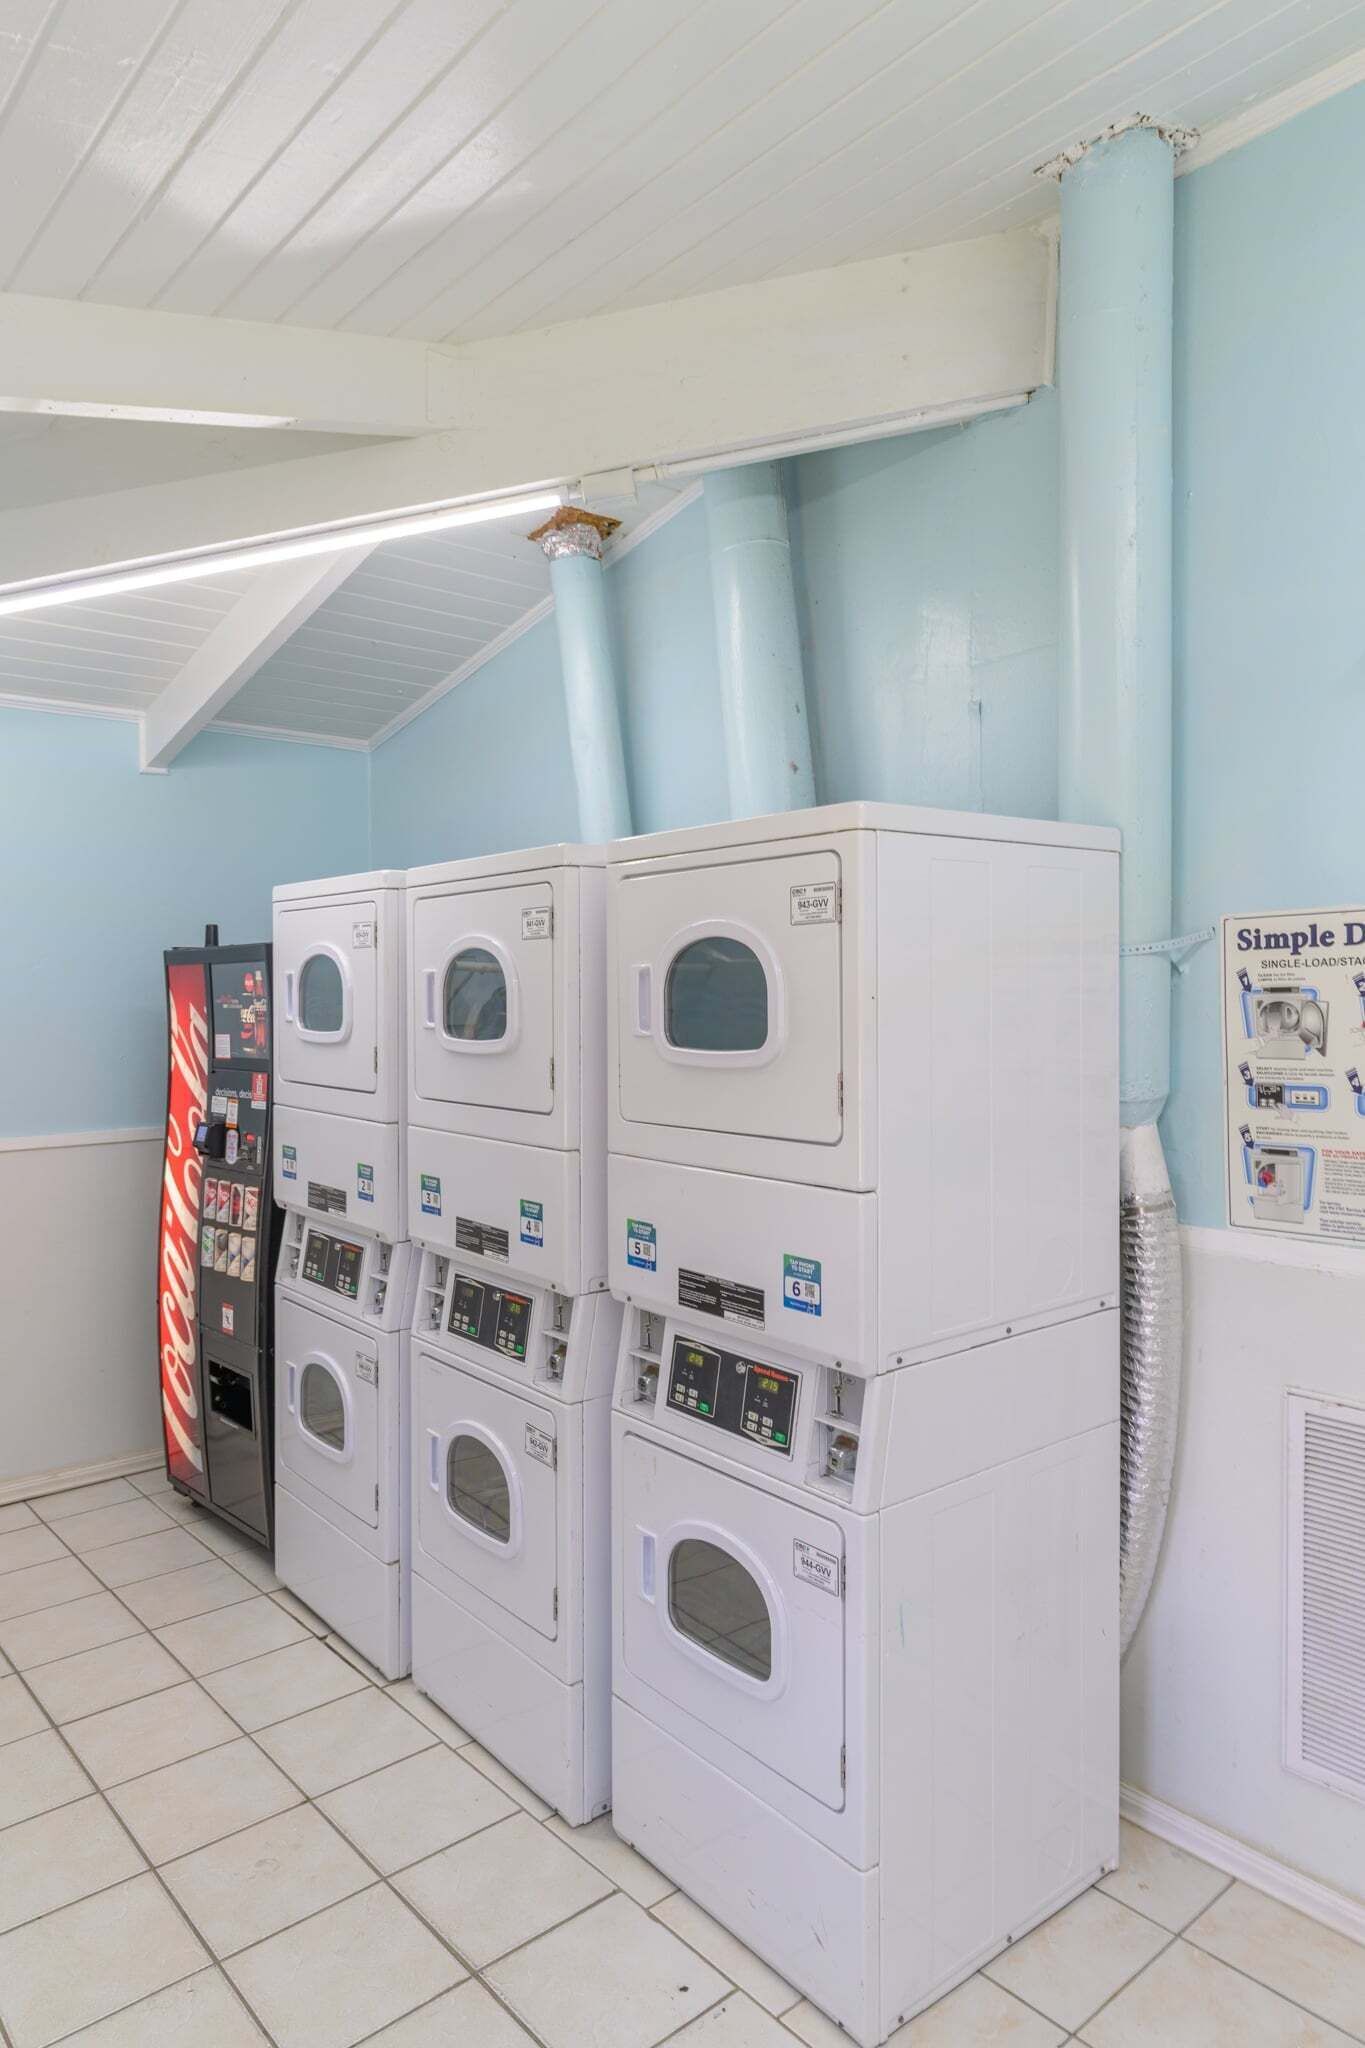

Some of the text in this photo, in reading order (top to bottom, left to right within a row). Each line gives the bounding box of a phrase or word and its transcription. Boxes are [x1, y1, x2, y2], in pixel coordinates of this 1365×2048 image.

[1237, 923, 1335, 956] Simple
[426, 1192, 431, 1204] 3
[526, 1220, 532, 1233] 4
[634, 1241, 641, 1255] 5
[792, 1281, 801, 1297] 6
